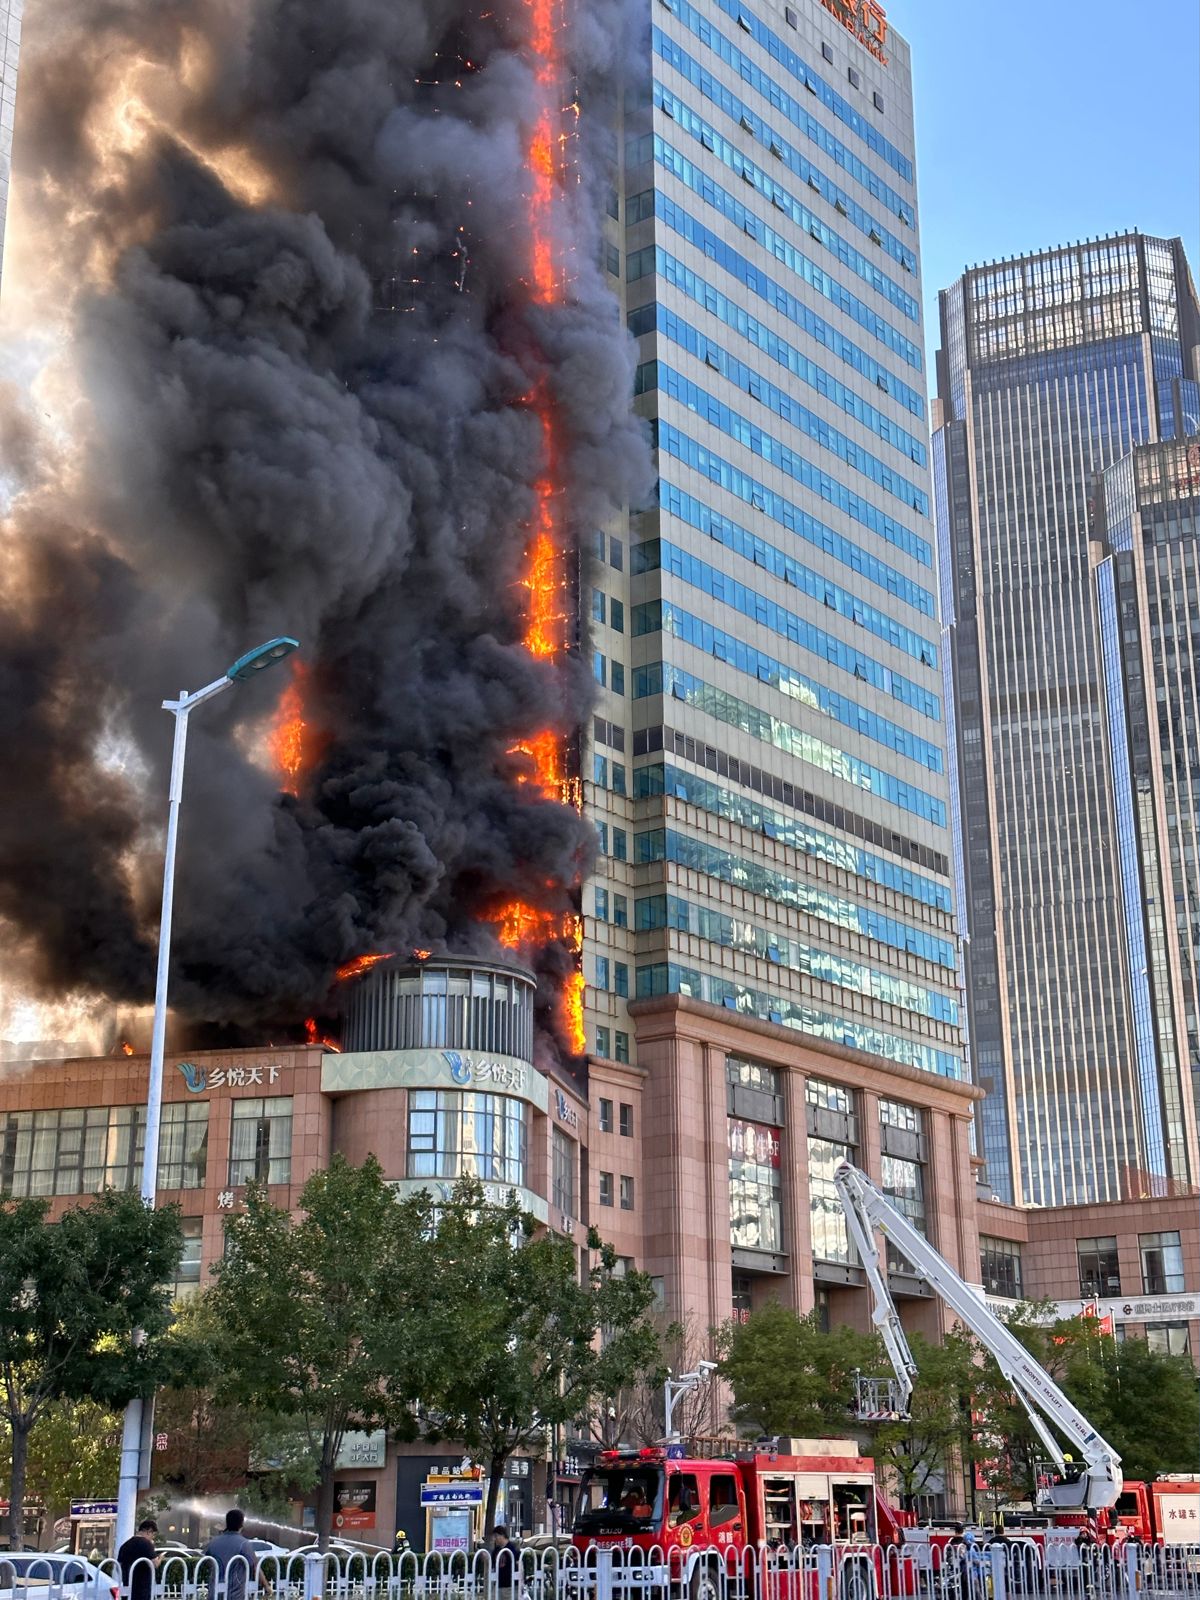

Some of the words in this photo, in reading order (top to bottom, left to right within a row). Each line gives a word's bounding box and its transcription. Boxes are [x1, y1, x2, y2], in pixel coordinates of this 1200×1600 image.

[206, 1065, 282, 1090] 乡悦天下
[474, 1058, 526, 1091] 乡悦天下
[1022, 1364, 1042, 1386] BRONTO
[1043, 1387, 1063, 1408] SKYLIFT
[1168, 1510, 1198, 1520] 水罐车
